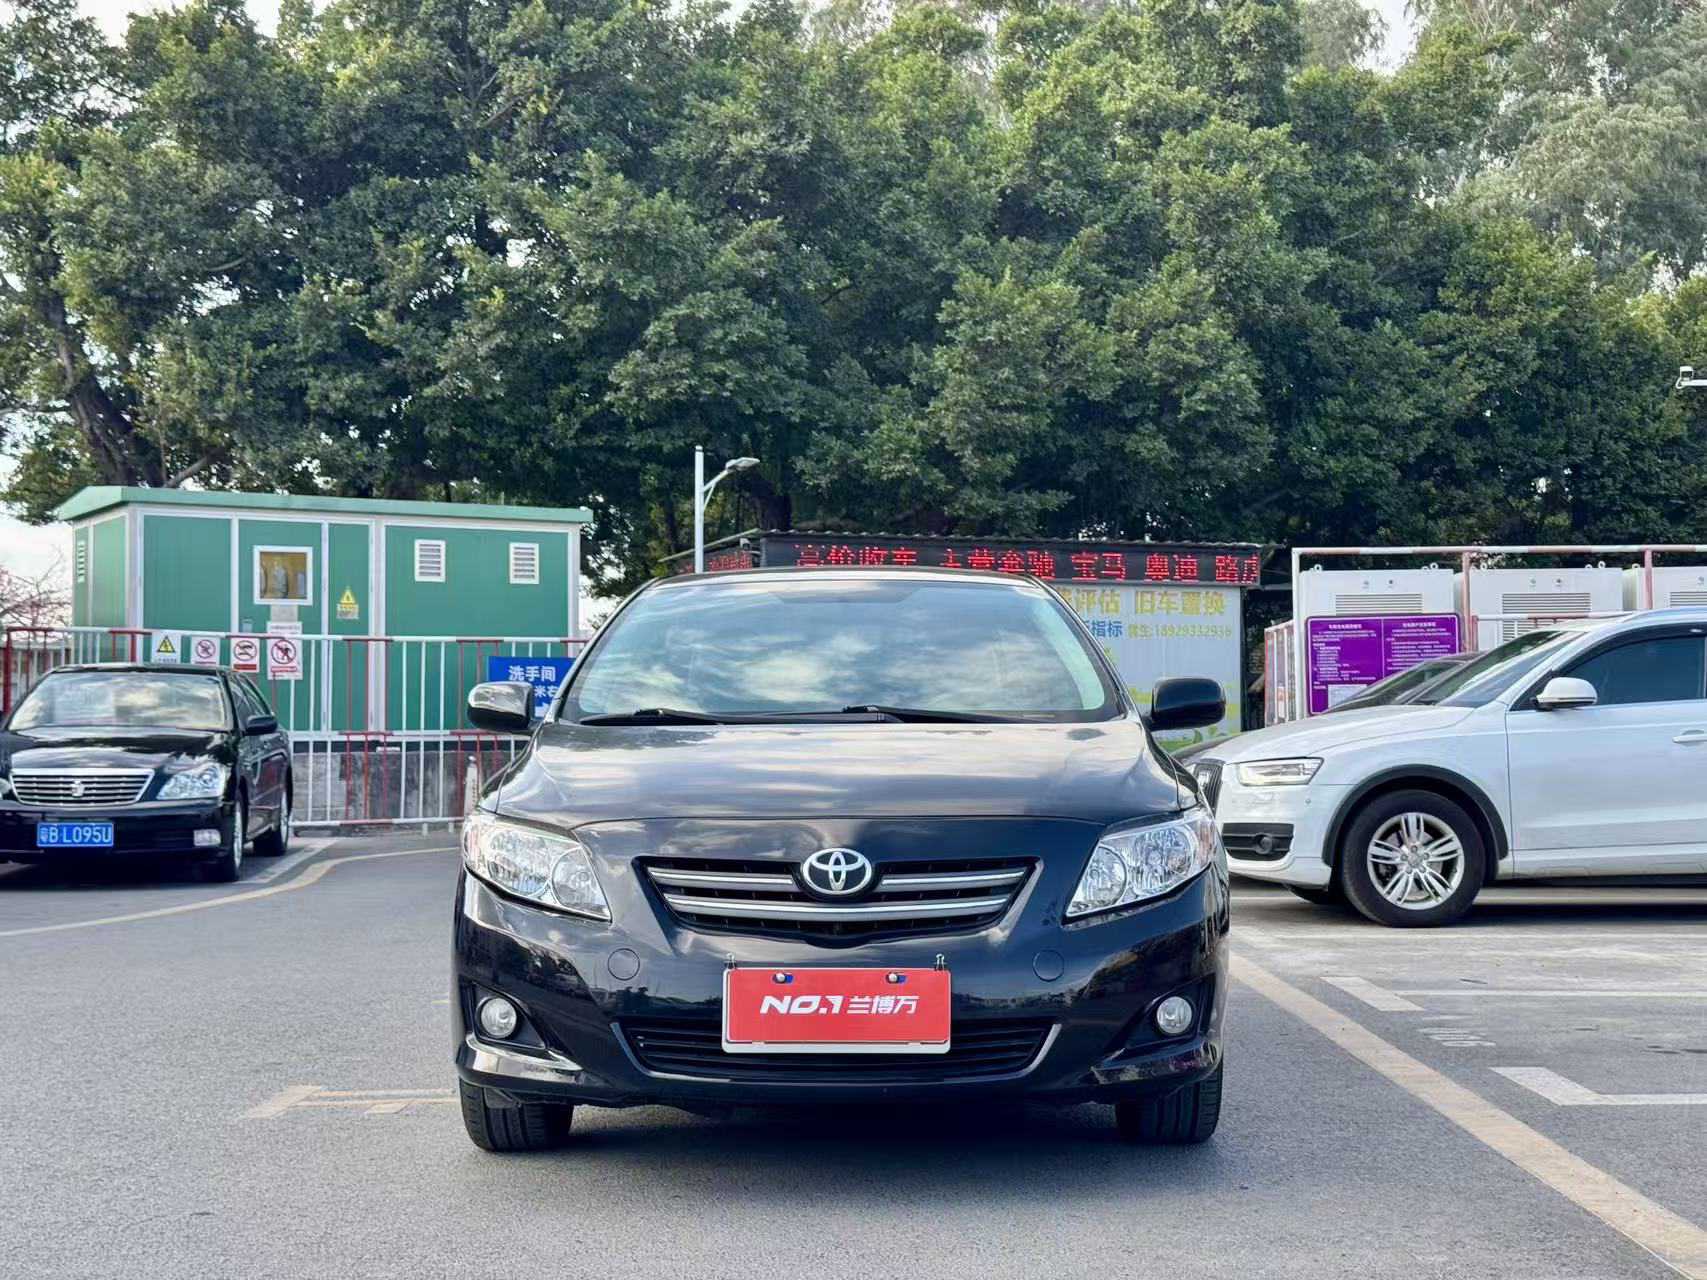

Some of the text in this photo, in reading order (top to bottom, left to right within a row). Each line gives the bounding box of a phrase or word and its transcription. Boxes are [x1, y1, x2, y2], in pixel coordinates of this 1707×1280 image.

[1071, 552, 1126, 581] 宝马
[1144, 554, 1199, 582] 奥迪
[1135, 590, 1225, 615] 旧车置换
[508, 665, 556, 682] 洗手间
[760, 995, 920, 1015] NO.1 兰博万
